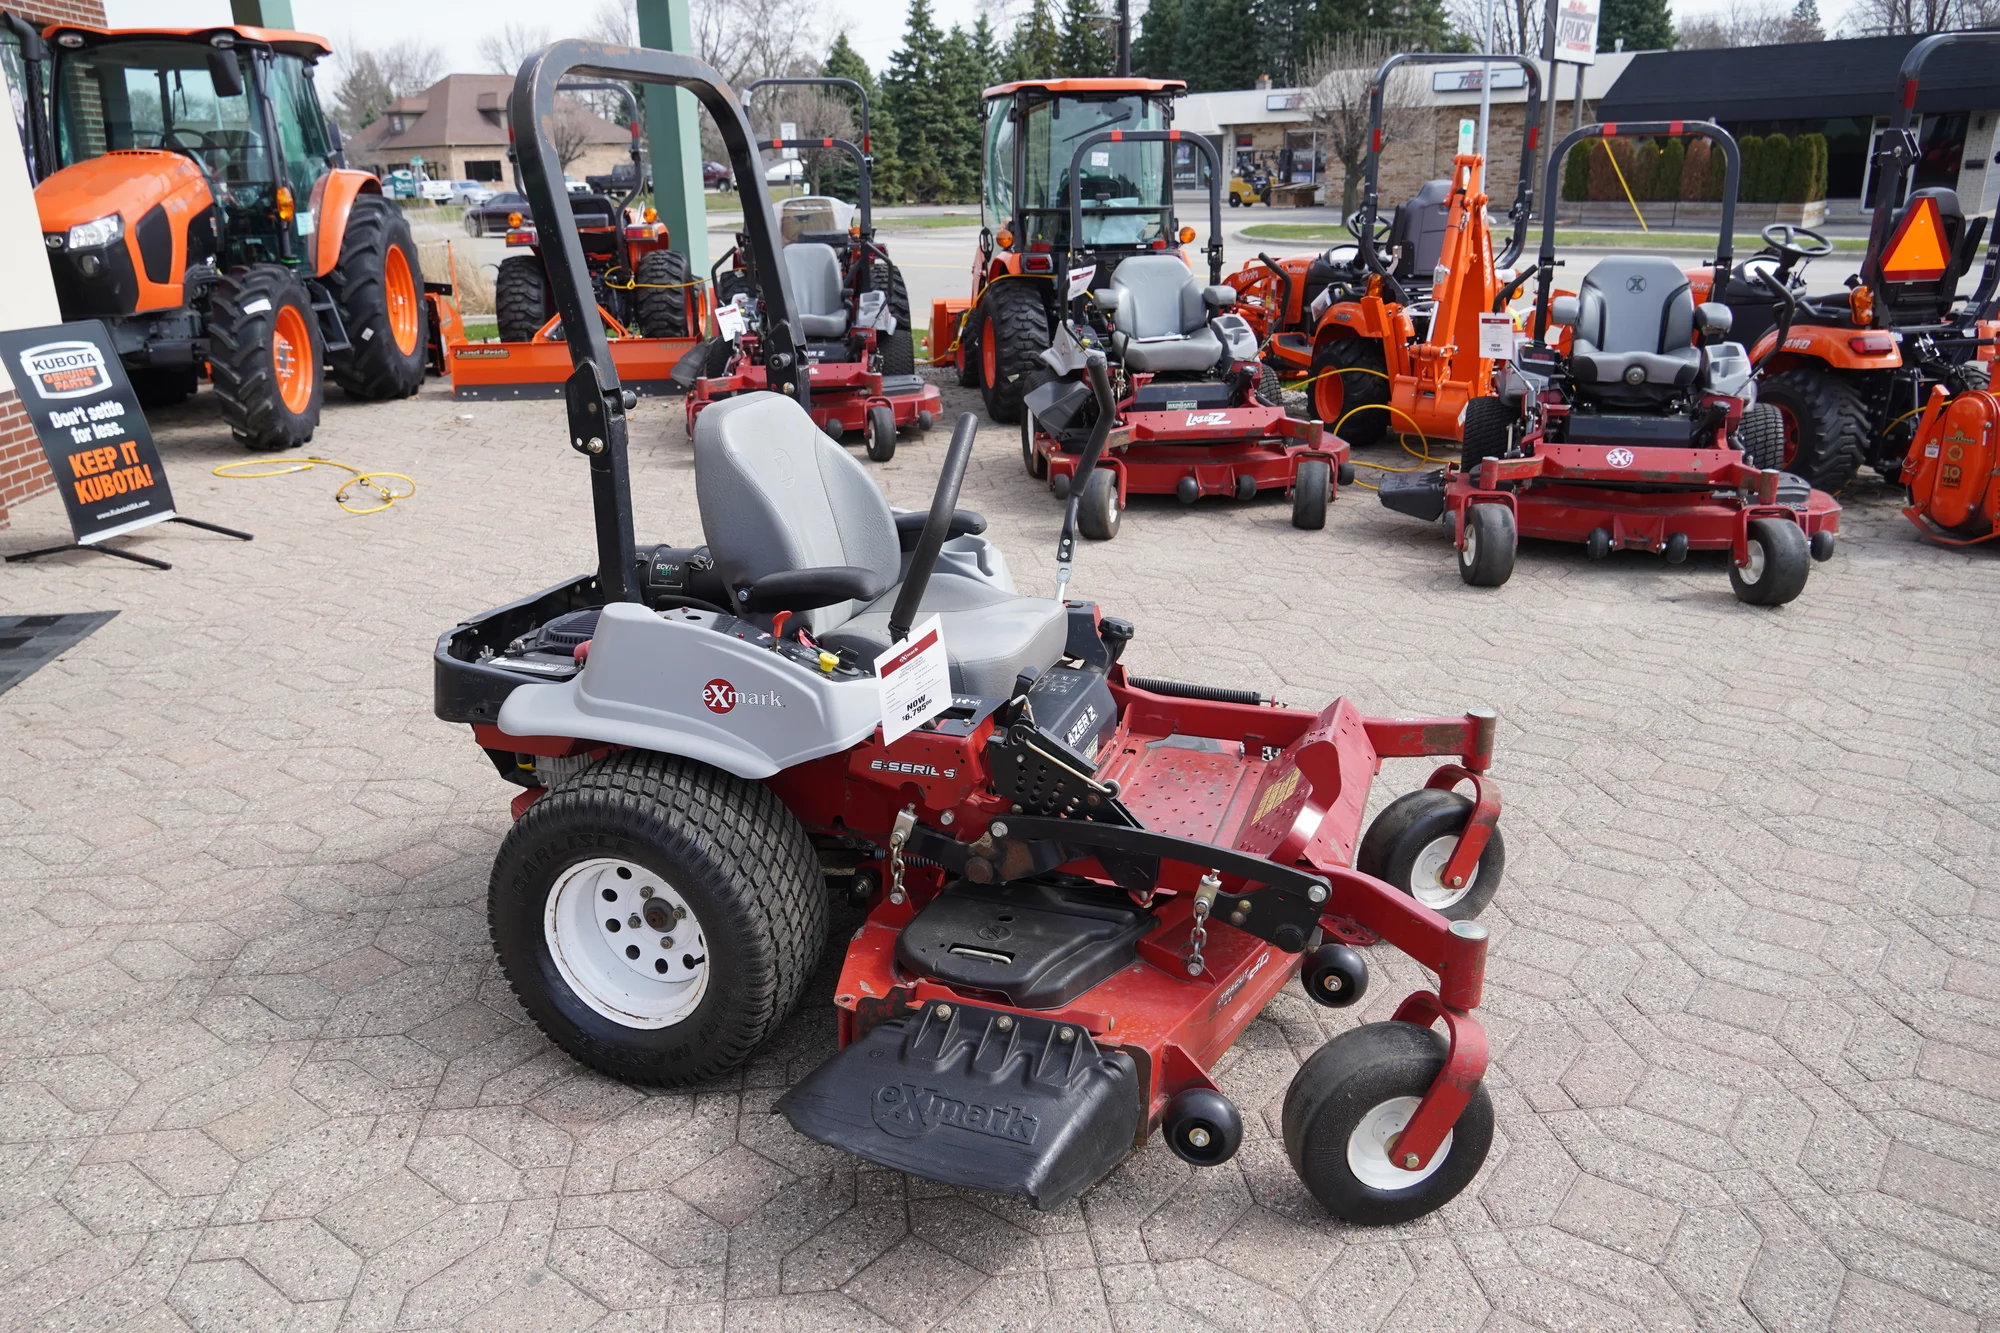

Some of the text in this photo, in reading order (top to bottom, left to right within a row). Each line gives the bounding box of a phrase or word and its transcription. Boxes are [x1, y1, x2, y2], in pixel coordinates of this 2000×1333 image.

[32, 353, 97, 372] KUBOTA
[43, 367, 97, 384] GENUINE
[54, 378, 94, 392] PARTS
[49, 400, 125, 429] Don't settle
[71, 421, 125, 444] for less.
[67, 440, 142, 479] KEEP IT
[1943, 464, 1961, 480] 10
[73, 463, 154, 505] KUBOTA!
[701, 684, 783, 709] eXmark
[906, 694, 926, 711] NOW
[1066, 711, 1091, 748] AZER
[1086, 703, 1099, 724] Z
[511, 832, 637, 896] CARLISLE
[877, 1082, 1035, 1139] eXmark
